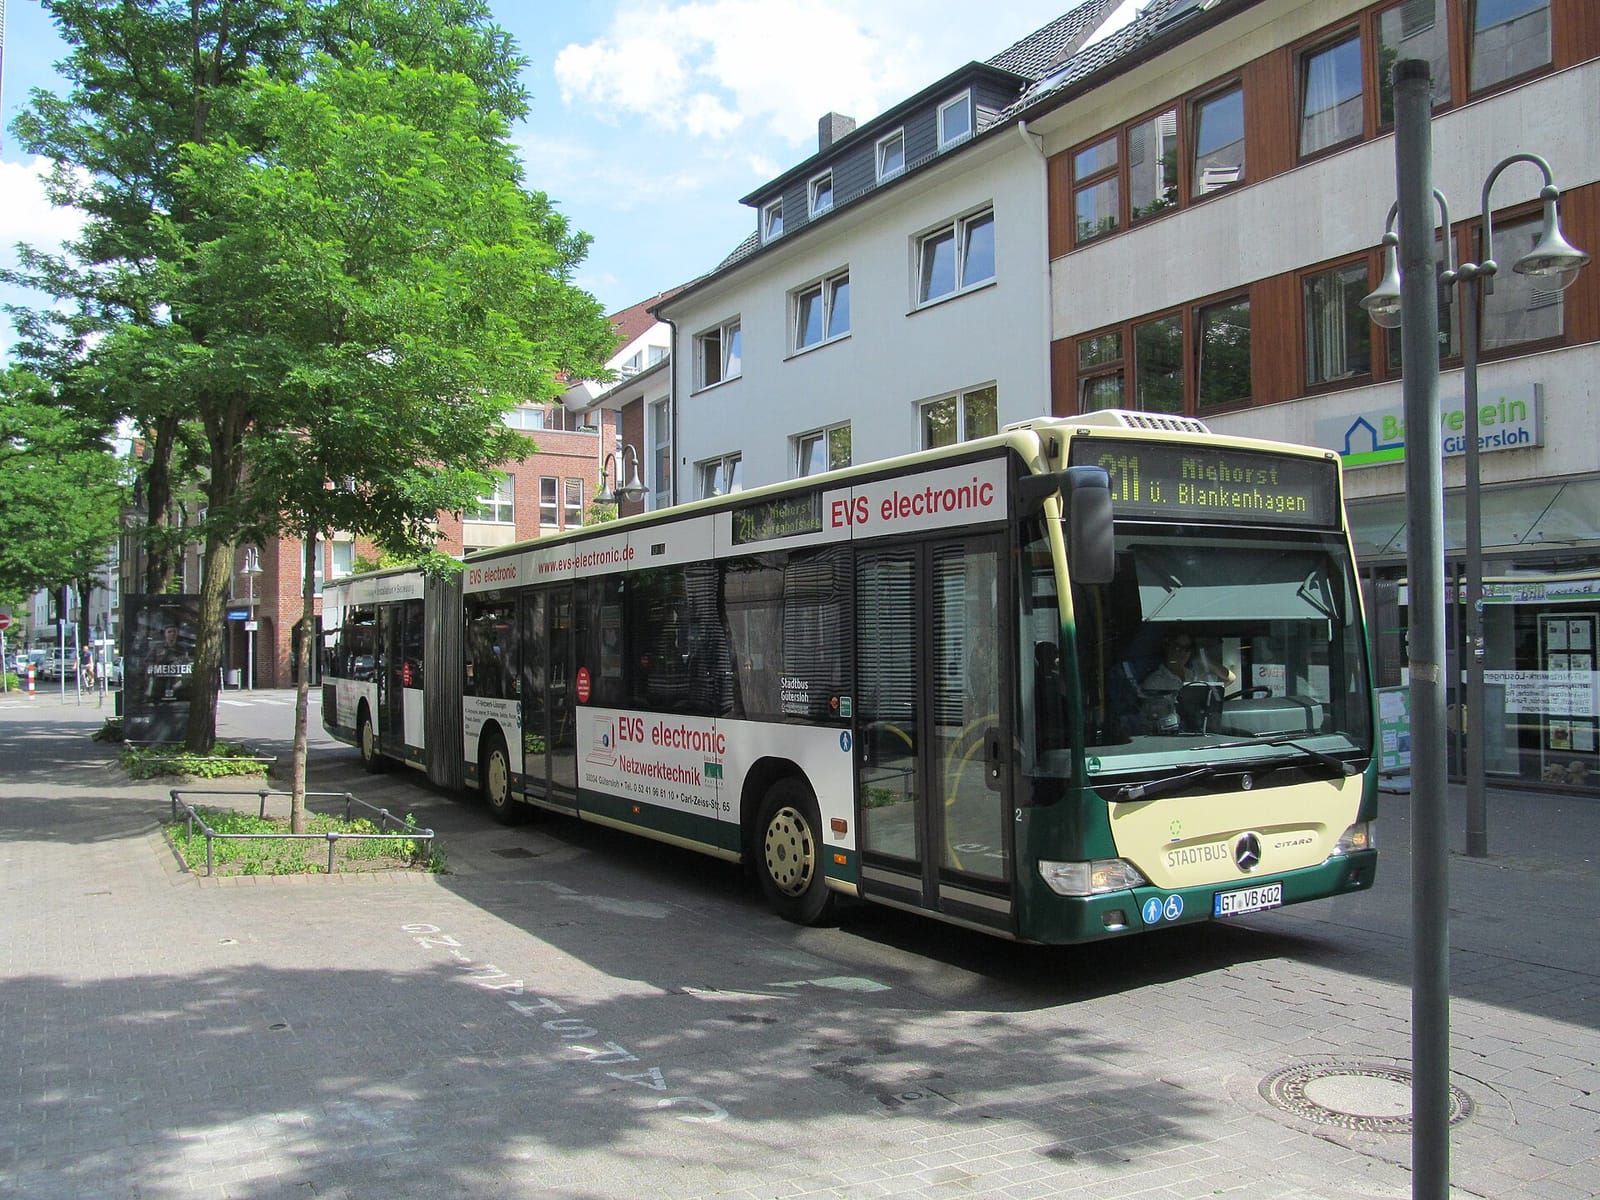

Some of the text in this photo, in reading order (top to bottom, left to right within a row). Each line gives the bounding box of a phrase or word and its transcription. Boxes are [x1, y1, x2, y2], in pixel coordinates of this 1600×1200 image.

[1382, 396, 1526, 441] Beein
[1443, 427, 1529, 453] Güersloh
[831, 476, 994, 528] EVS electronic
[1179, 482, 1306, 513] Blankenhagen
[538, 544, 634, 574] www.evs-electronic.de
[469, 563, 517, 585] EVS electronic
[147, 664, 192, 674] #MEISTER
[781, 677, 808, 689] Stadtbus
[781, 690, 808, 702] Gütersloh
[618, 716, 726, 755] EVS electronic
[619, 755, 701, 786] Netzwerktechnik
[680, 792, 721, 810] Carl-Zeiss-Str.
[722, 801, 730, 812] 65
[1015, 808, 1022, 822] 2
[1168, 844, 1228, 867] STADTBUS
[1275, 838, 1313, 849] CITARO
[1222, 886, 1280, 911] GT VB 602
